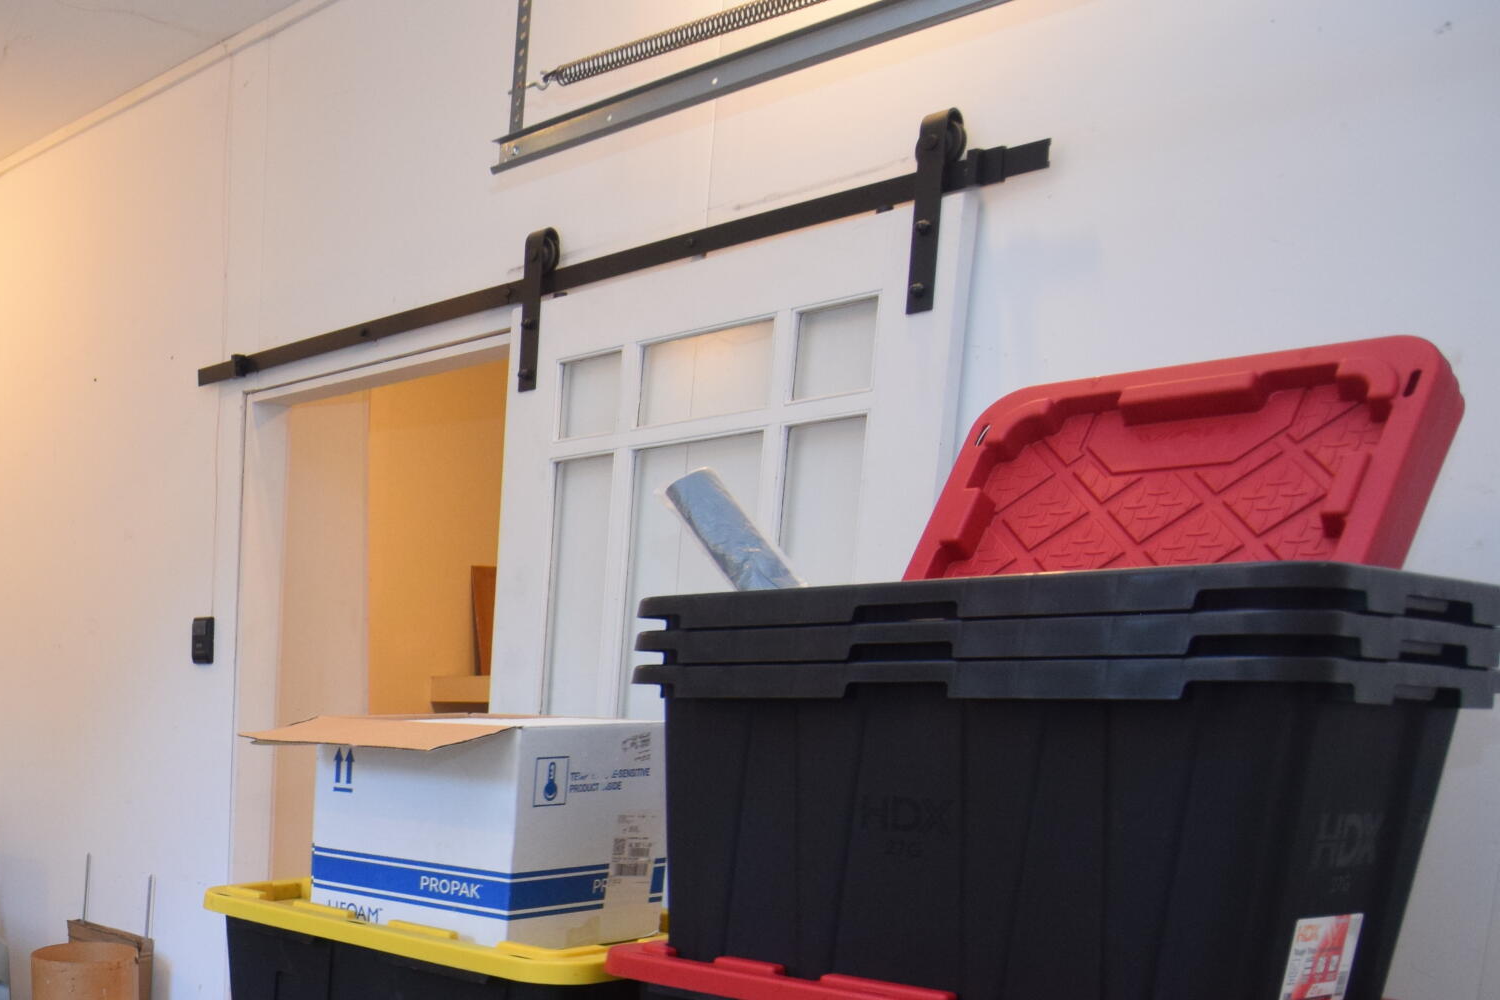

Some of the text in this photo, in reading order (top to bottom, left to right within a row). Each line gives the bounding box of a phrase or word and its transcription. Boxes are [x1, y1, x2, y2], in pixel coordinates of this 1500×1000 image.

[569, 781, 622, 792] PRODUCT SIDE
[861, 794, 954, 838] HDX
[1311, 811, 1385, 870] HDX
[420, 875, 481, 899] PROPAK
